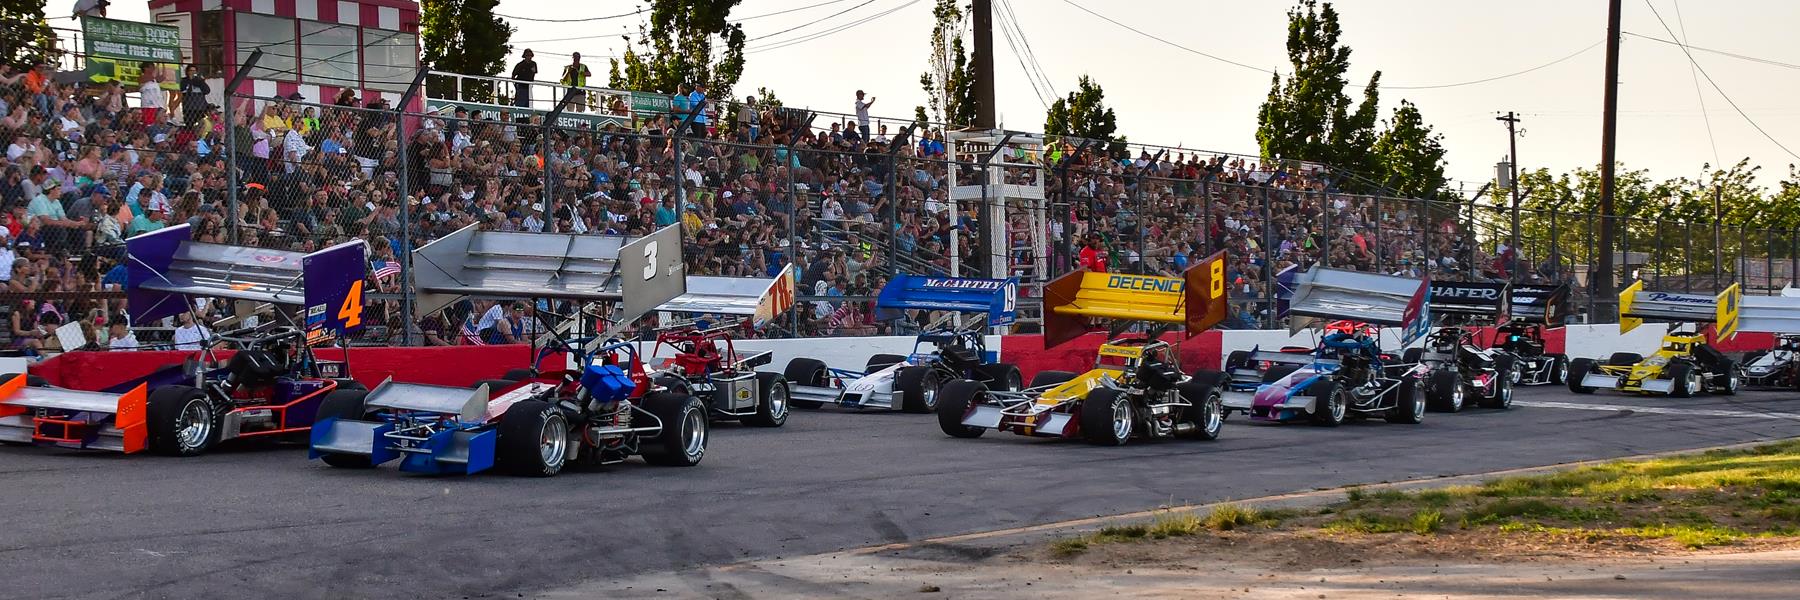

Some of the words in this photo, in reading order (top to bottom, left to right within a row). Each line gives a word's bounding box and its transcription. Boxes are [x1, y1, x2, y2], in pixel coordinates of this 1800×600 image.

[111, 24, 143, 37] Reliable
[145, 27, 179, 46] BOB'S
[93, 40, 127, 55] SMOKE
[128, 44, 150, 57] FREE
[152, 47, 174, 60] ZONE
[643, 240, 658, 281] 3
[922, 278, 1003, 291] McCARTHY
[1211, 258, 1224, 300] 8
[337, 279, 363, 328] 4
[1003, 282, 1016, 313] 19
[1430, 286, 1498, 300] HAFER
[1649, 292, 1714, 304] Pedersen
